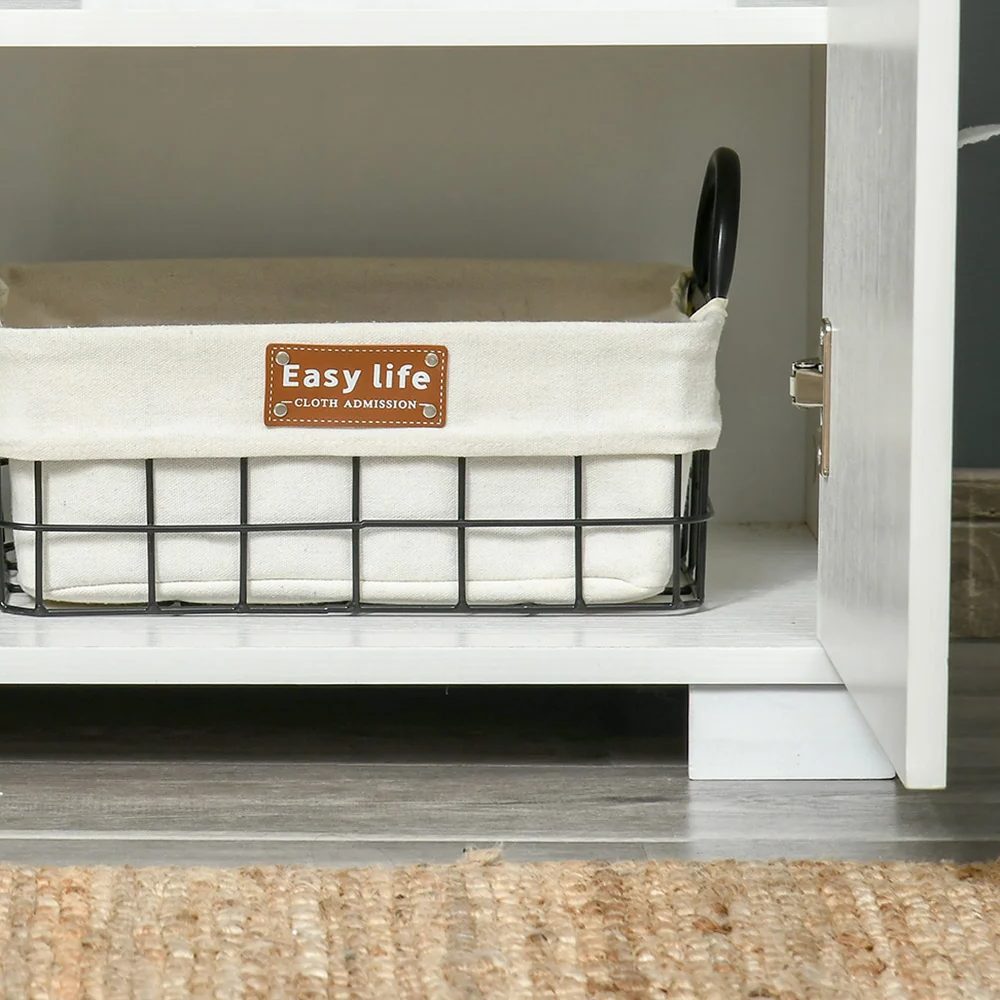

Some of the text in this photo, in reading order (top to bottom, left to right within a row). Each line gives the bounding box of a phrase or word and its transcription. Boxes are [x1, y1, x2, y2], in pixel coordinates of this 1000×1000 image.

[282, 364, 431, 394] Easy life
[295, 399, 416, 409] CLOTH ADMISSION
